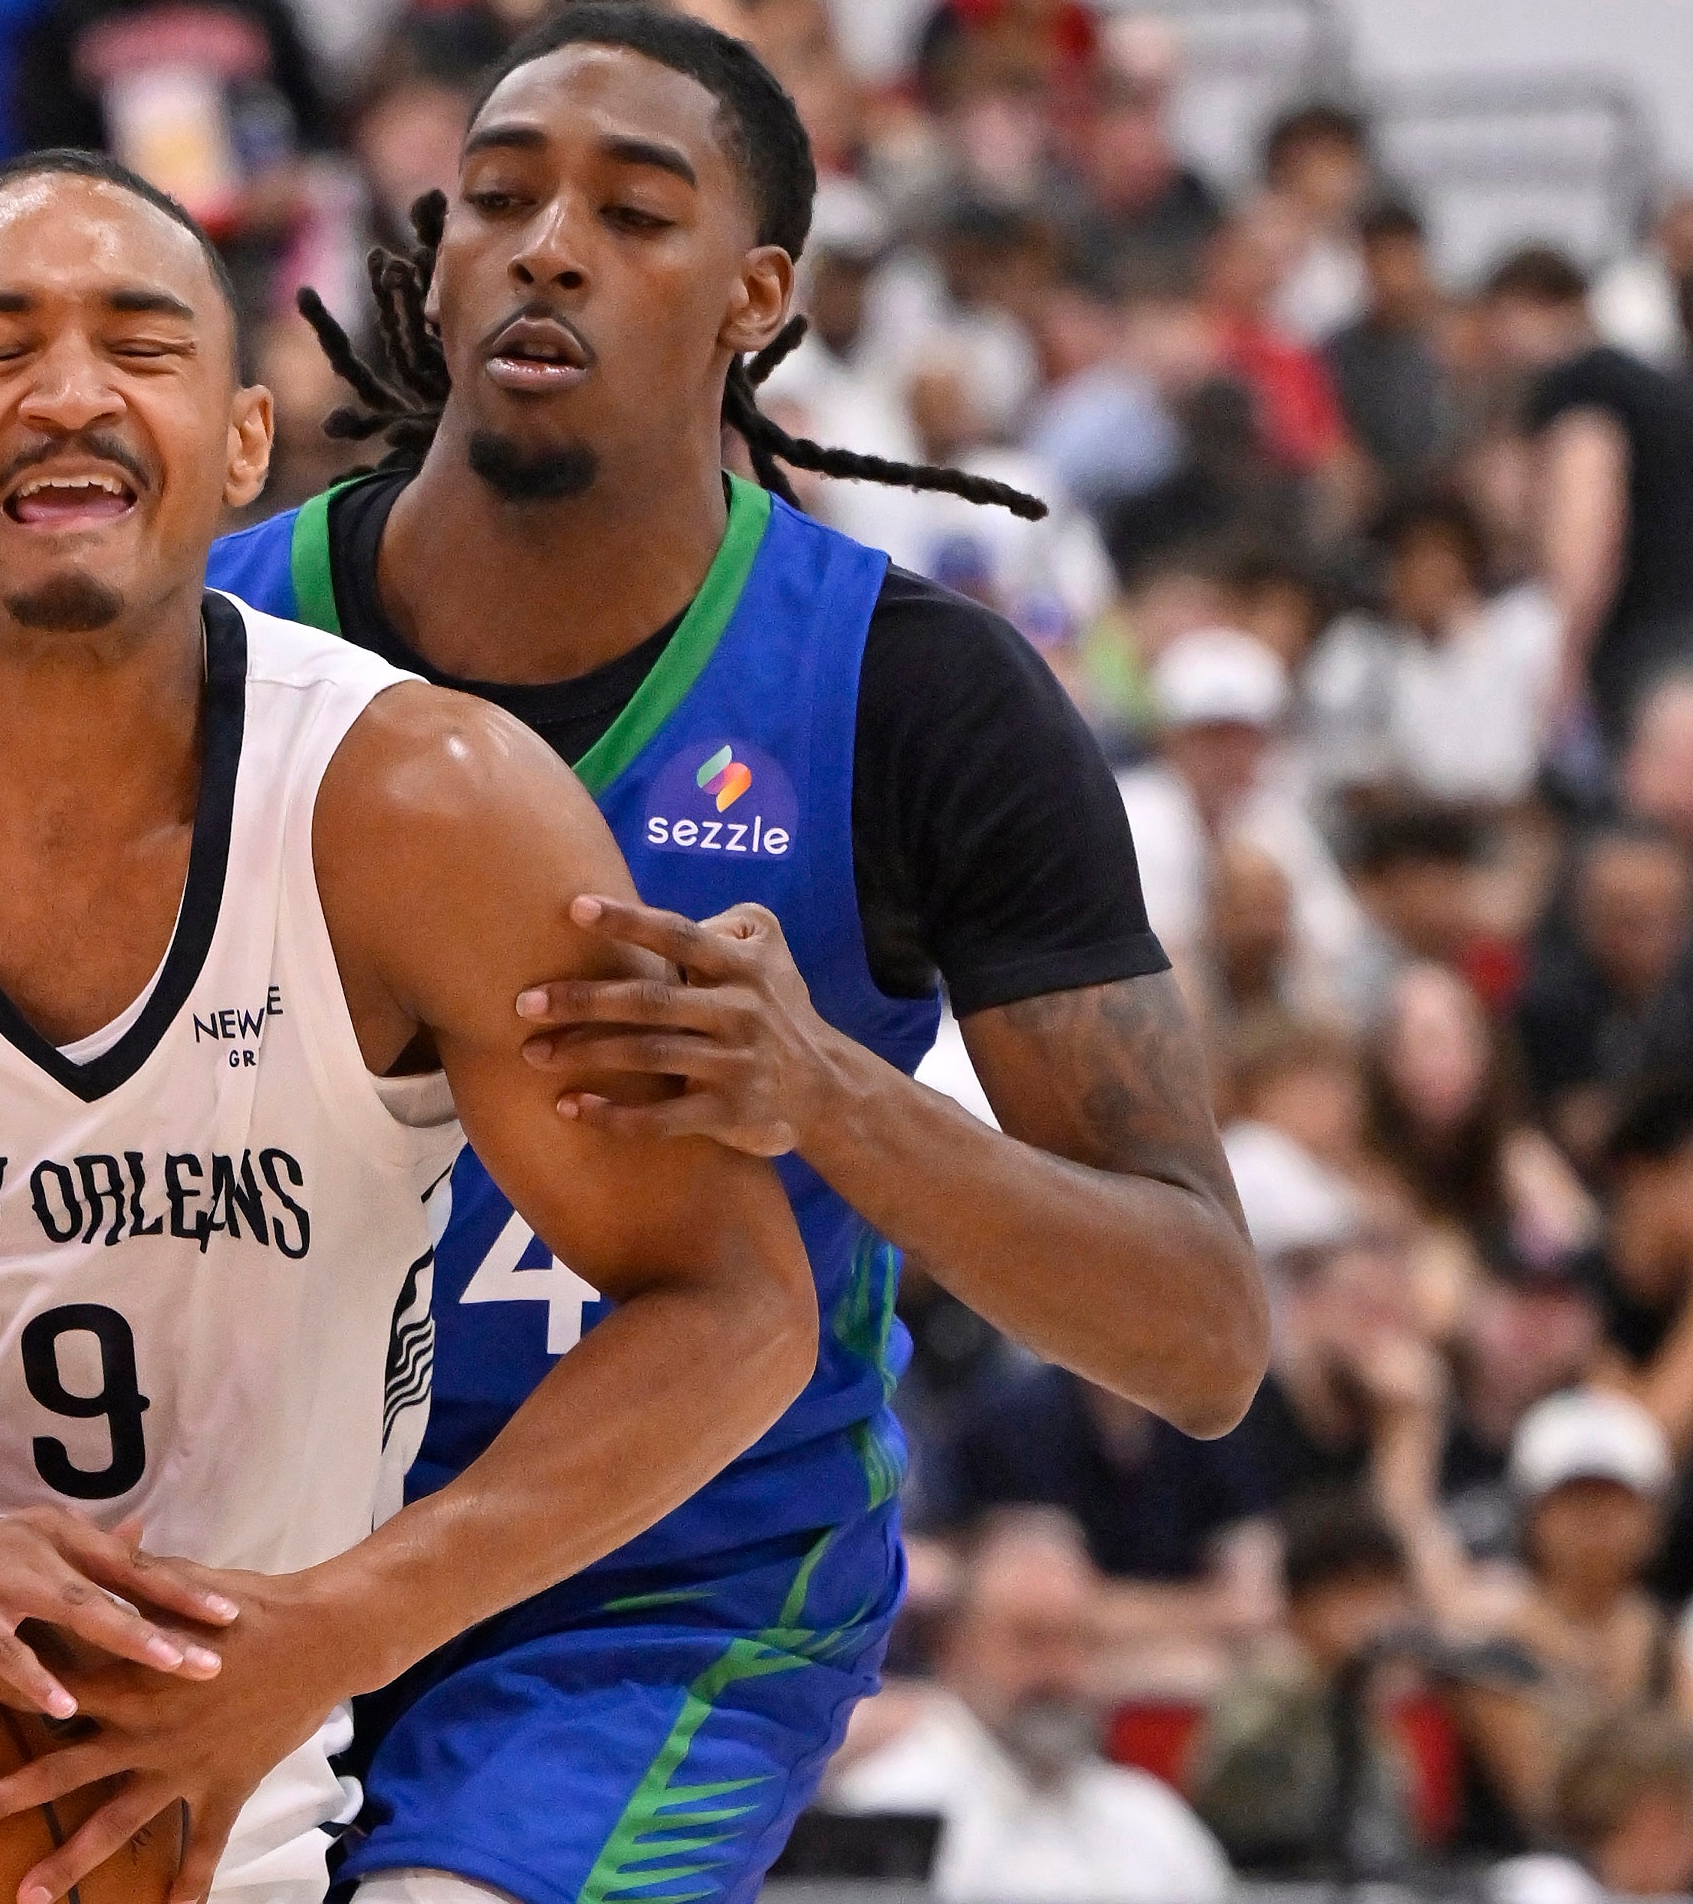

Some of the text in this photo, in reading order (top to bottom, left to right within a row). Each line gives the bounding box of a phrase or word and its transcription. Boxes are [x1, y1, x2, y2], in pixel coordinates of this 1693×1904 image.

[648, 815, 790, 855] sezzle
[30, 1148, 311, 1259] ORLEANS
[20, 1304, 150, 1500] 9
